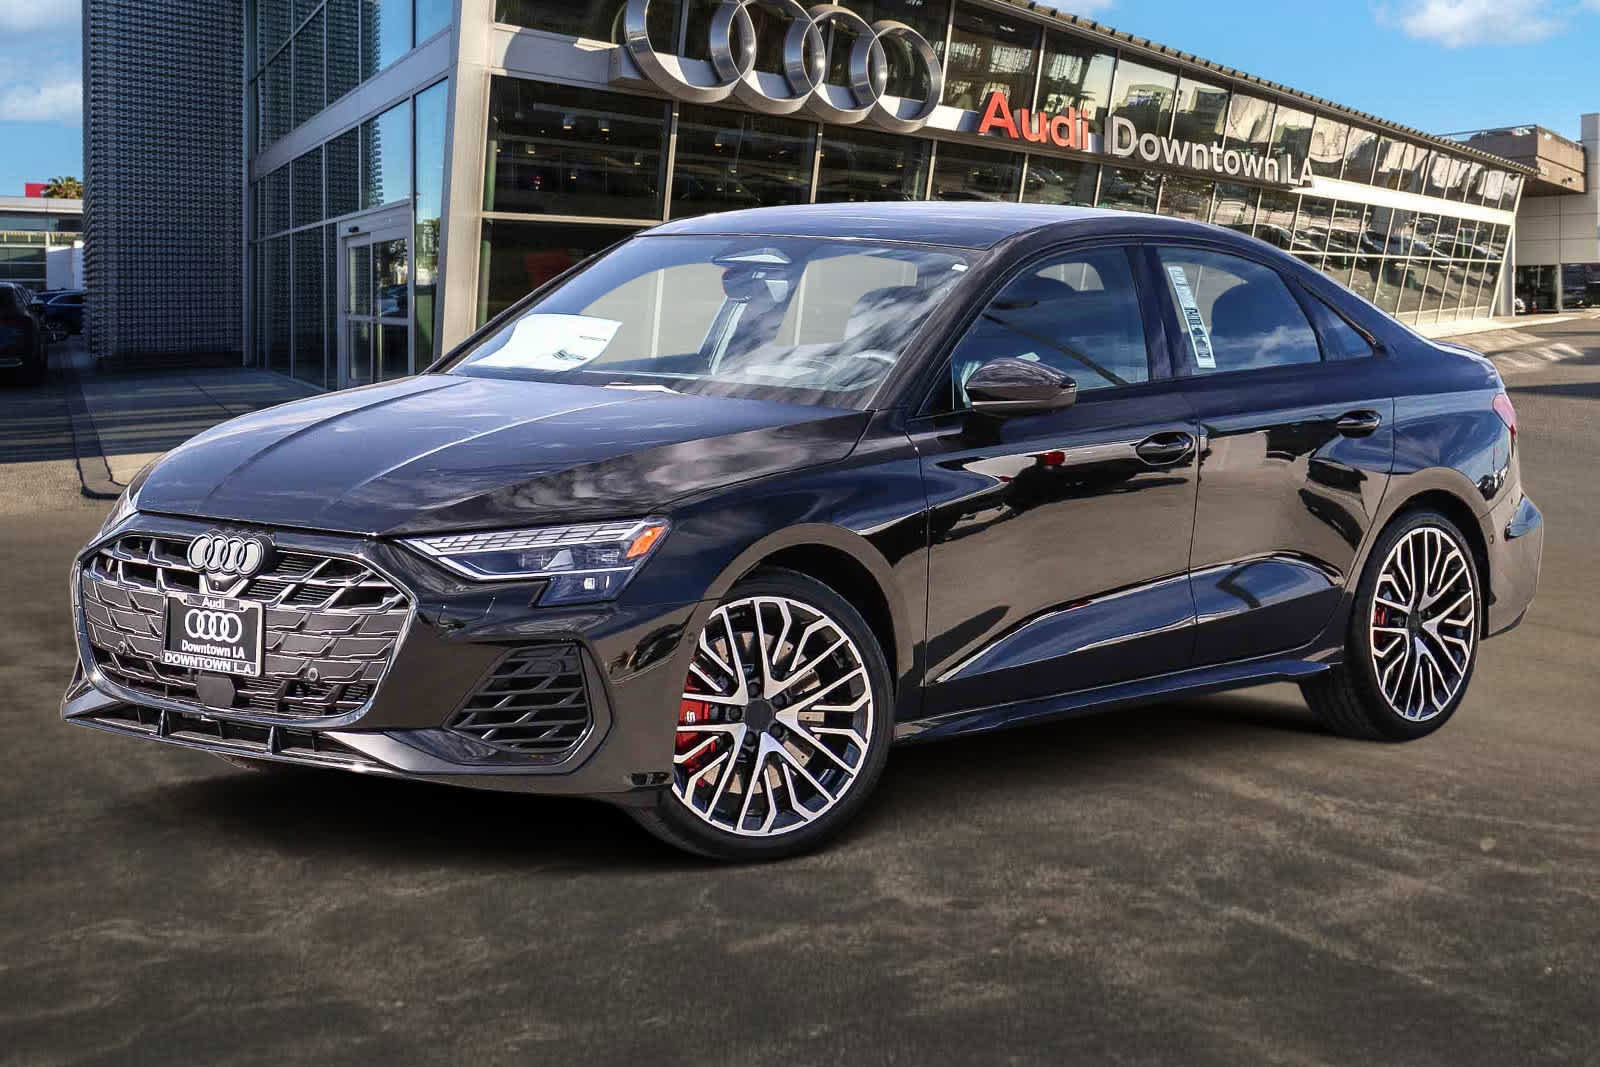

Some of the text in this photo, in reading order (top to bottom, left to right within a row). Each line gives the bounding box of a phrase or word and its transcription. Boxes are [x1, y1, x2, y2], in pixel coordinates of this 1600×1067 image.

[978, 91, 1315, 188] Audi Downtown LA
[202, 596, 225, 609] Audi
[182, 640, 245, 659] Downtown LA
[165, 653, 231, 672] DOWNTOWN
